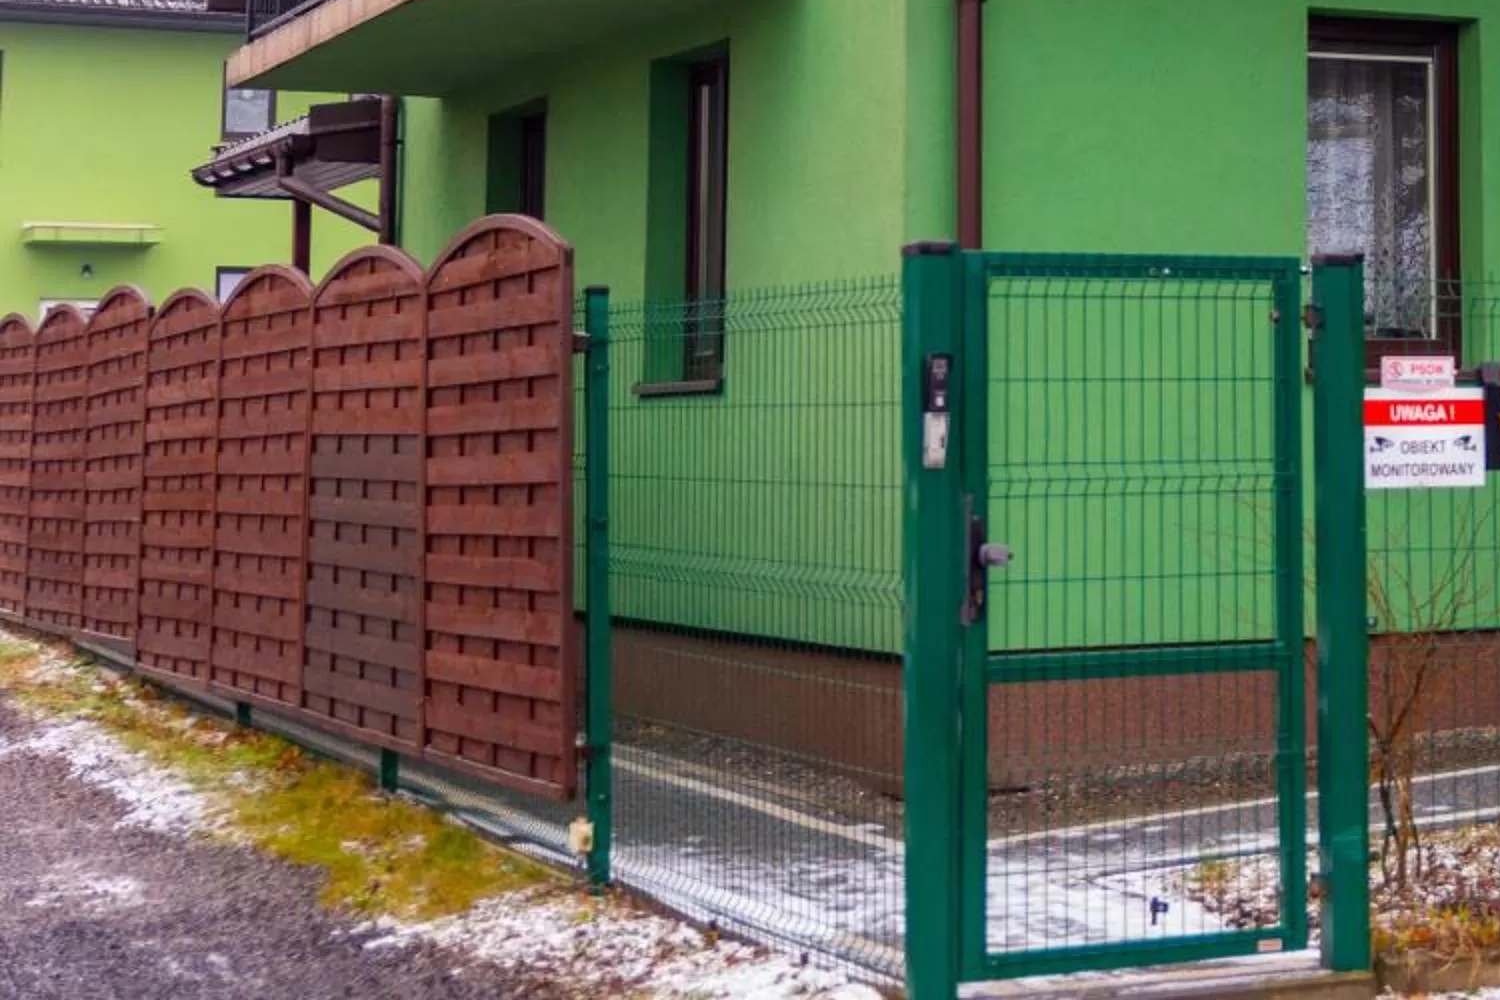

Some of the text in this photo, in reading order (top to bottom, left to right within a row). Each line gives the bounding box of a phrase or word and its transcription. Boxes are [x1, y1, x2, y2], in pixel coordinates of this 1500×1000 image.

[1389, 404, 1448, 421] UWAGA
[1400, 440, 1446, 454] OBIEKT
[1371, 463, 1475, 477] MONITOROWANY
